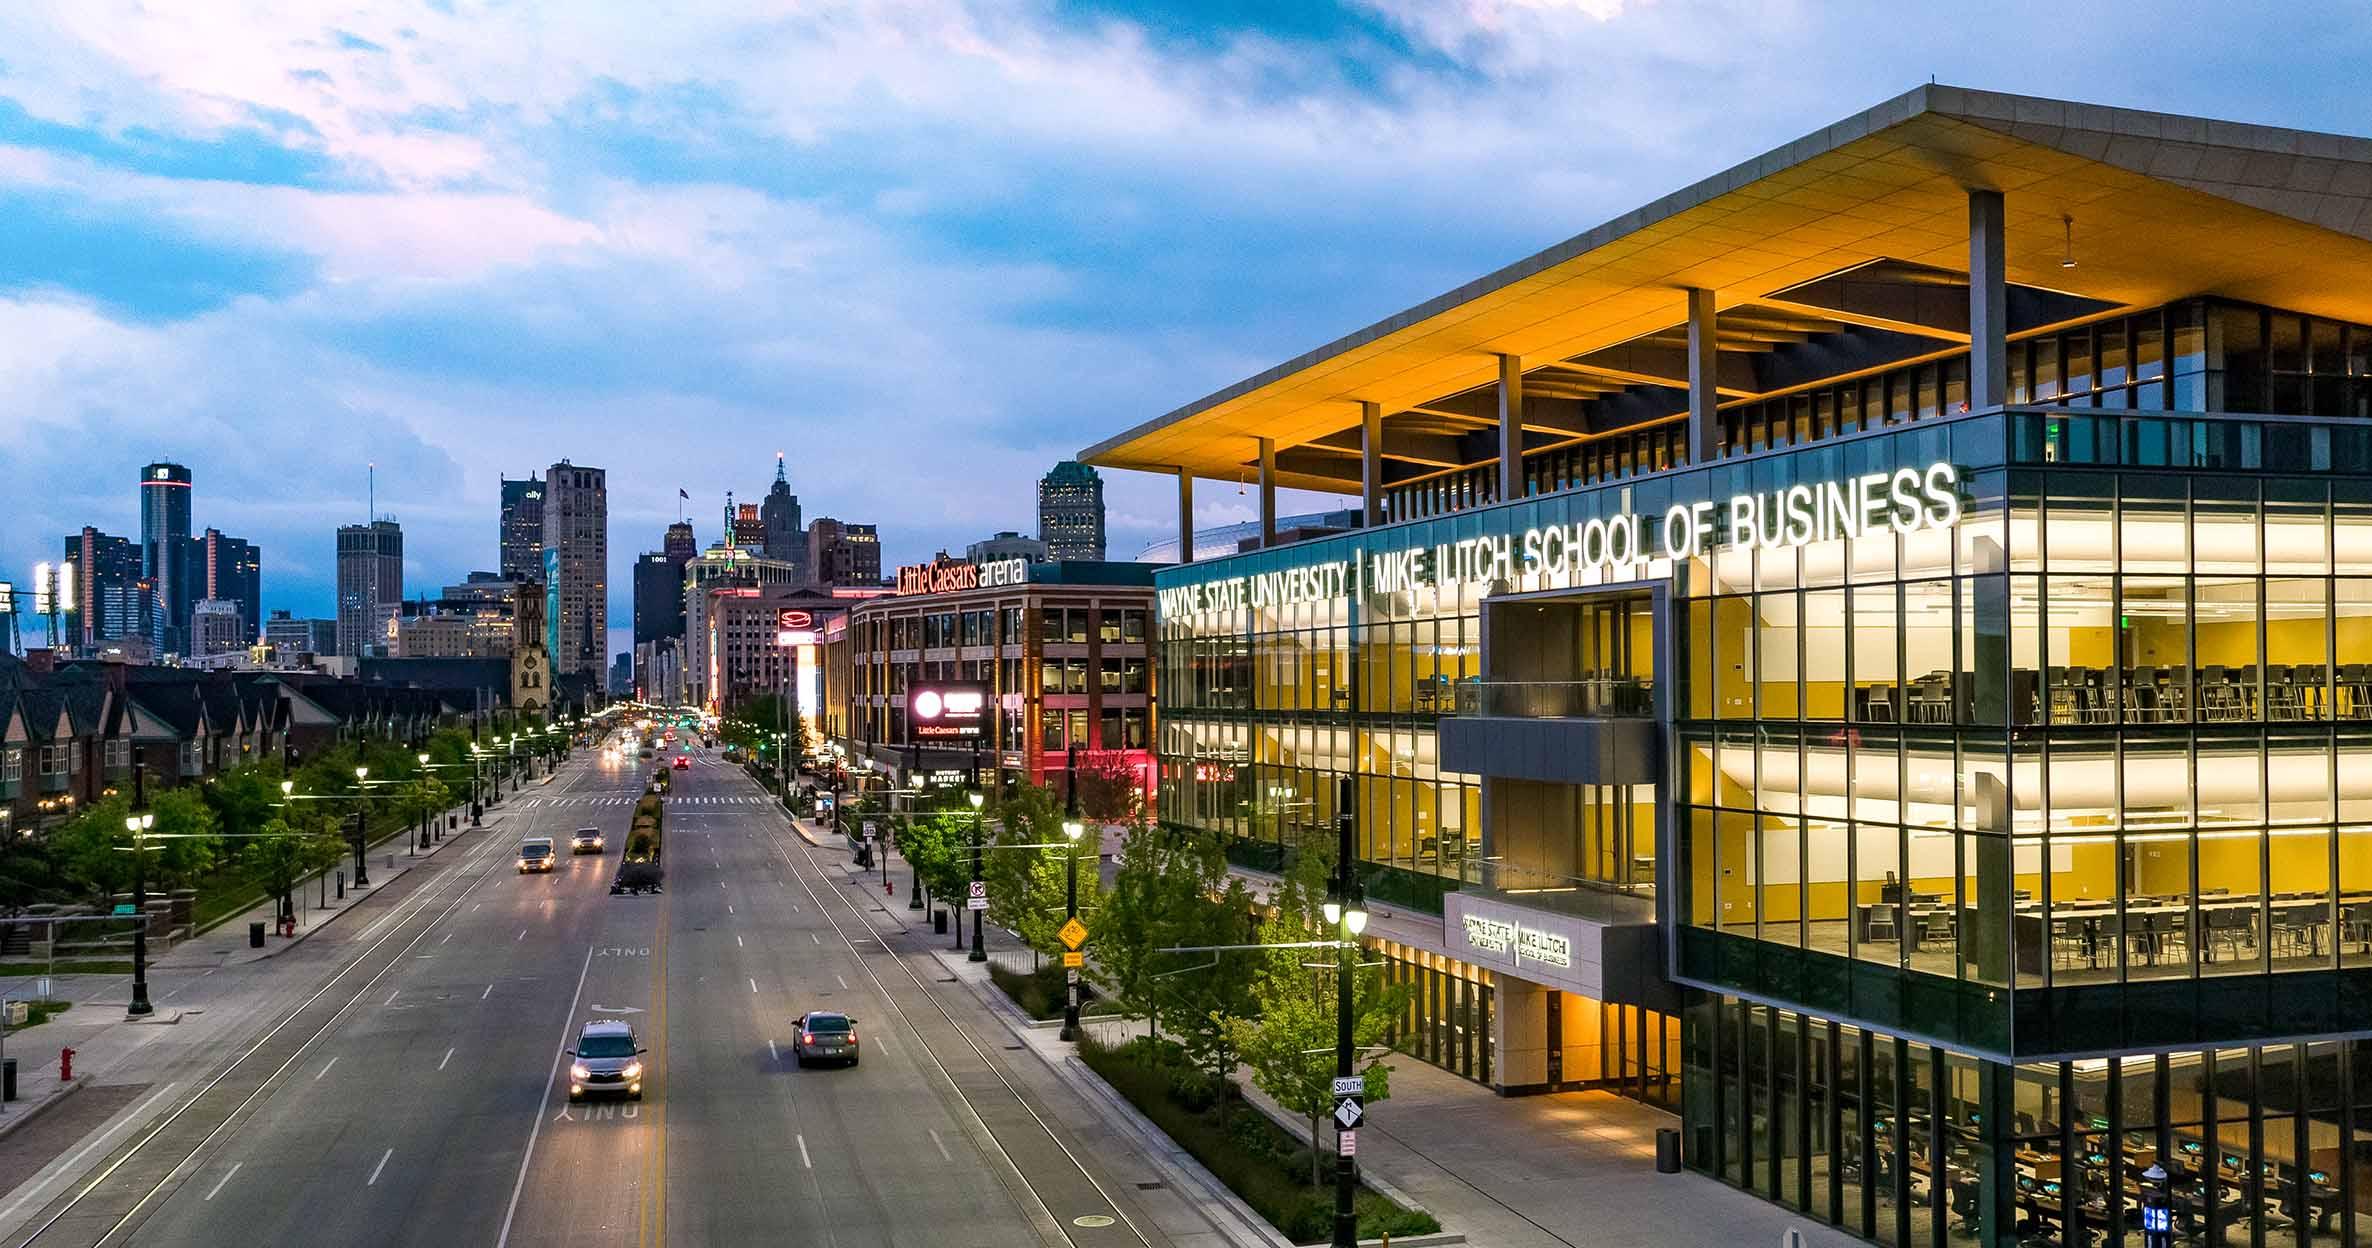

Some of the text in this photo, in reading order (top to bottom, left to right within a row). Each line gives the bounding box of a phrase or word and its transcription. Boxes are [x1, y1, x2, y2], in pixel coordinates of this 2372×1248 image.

[526, 491, 541, 500] ally
[1374, 462, 1959, 593] MIKE ILITCH SCHOOL OF BUSINESS
[896, 558, 1024, 596] Little Caesars arena
[1159, 560, 1348, 619] WAYNE STATE UNIVERSITY
[930, 775, 965, 783] MARKET
[1487, 923, 1512, 941] STATE
[1519, 930, 1566, 955] MIKE ILITCH
[1335, 1081, 1362, 1092] SOUTH
